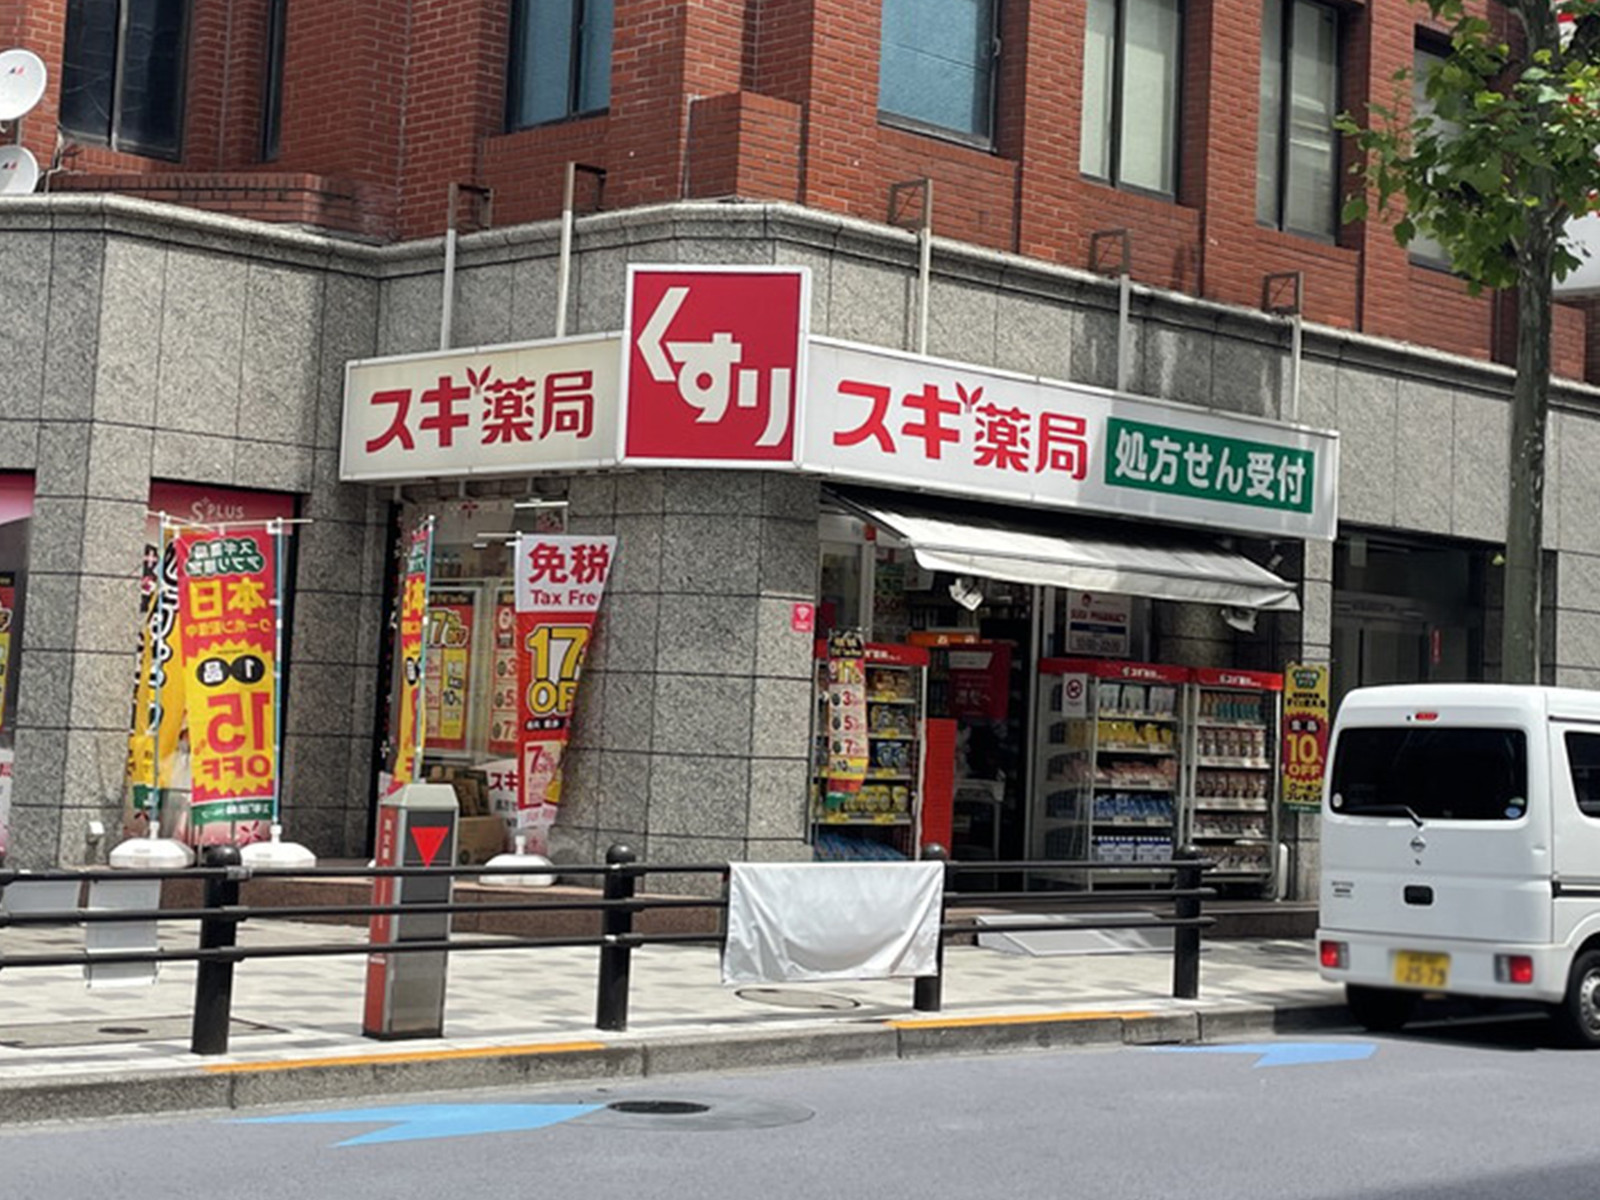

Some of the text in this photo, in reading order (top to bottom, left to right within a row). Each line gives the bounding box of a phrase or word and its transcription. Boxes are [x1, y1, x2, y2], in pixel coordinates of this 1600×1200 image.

[637, 287, 791, 446] くすり
[365, 365, 594, 453] スギ薬局
[833, 379, 1088, 481] スギ薬局
[1115, 428, 1307, 504] 処方せん受付
[528, 543, 609, 584] 免税
[531, 589, 598, 606] Tax Fre
[526, 625, 590, 680] 17
[530, 681, 577, 713] OF
